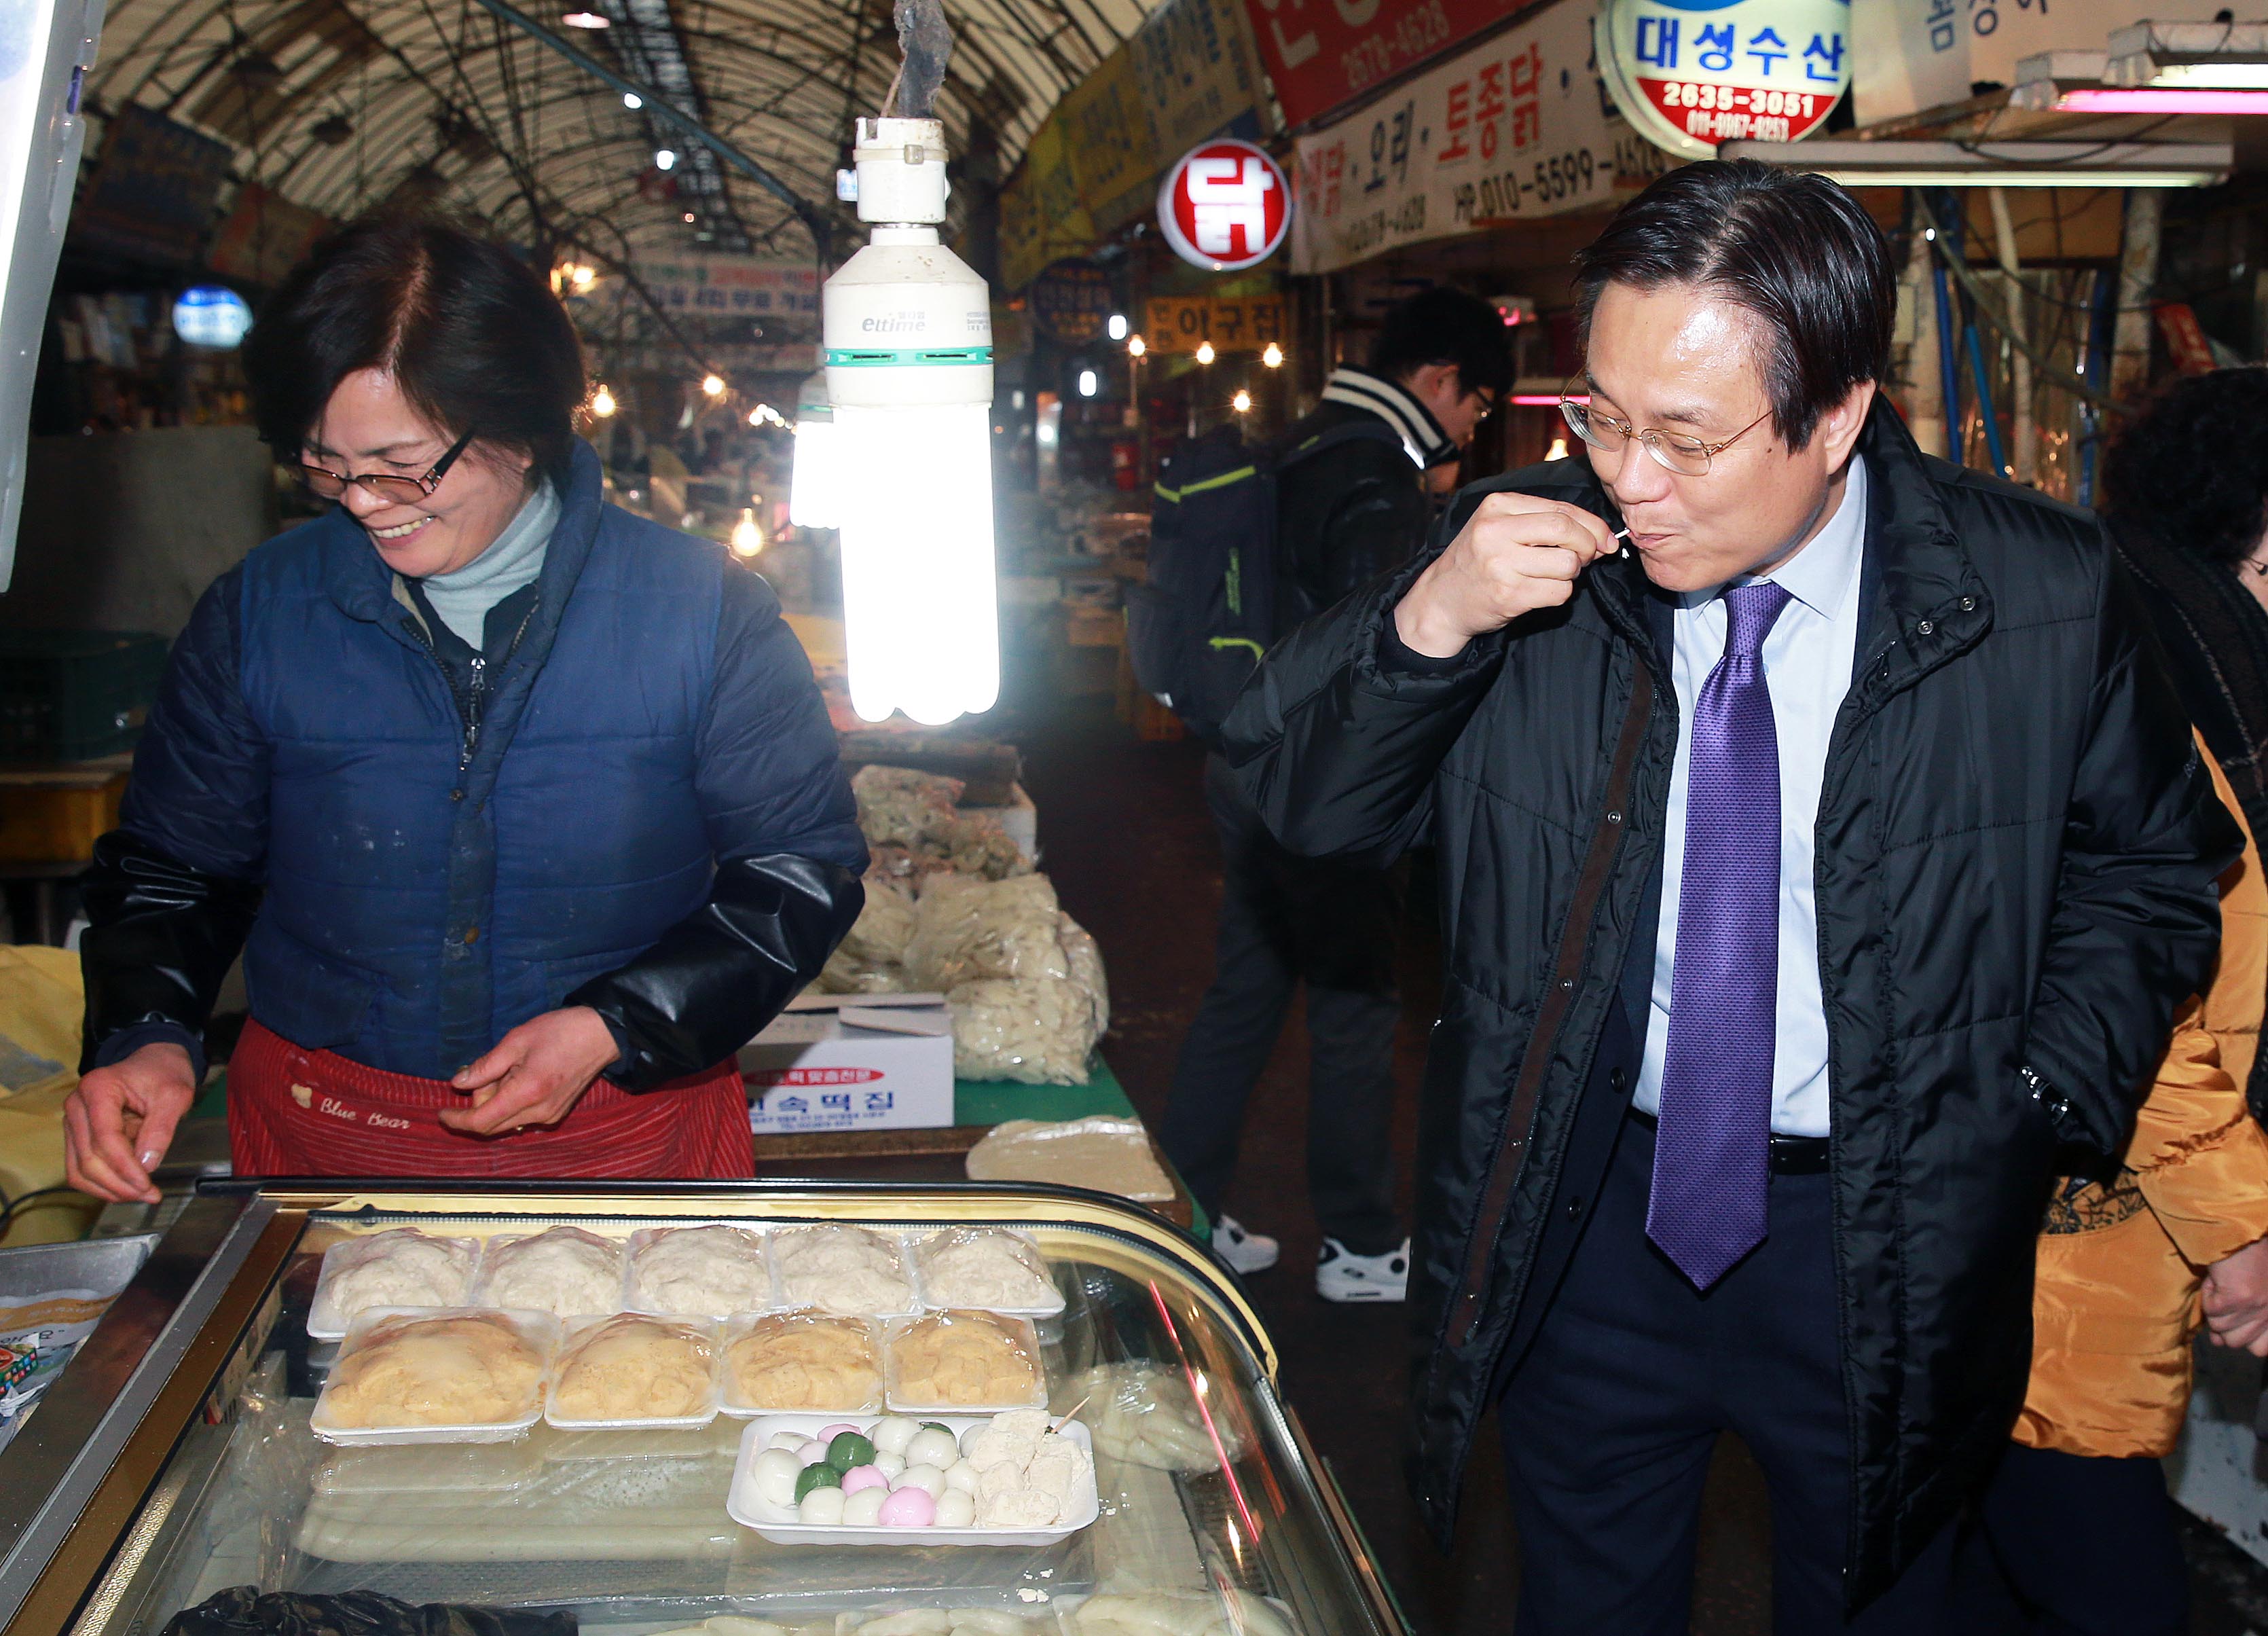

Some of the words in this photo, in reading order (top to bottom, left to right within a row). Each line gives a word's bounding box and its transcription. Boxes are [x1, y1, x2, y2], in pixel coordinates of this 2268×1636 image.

[1636, 17, 1844, 81] 대성수산
[1438, 41, 1543, 162] 토종닭
[1662, 81, 1814, 118] 2635-3051
[1186, 158, 1274, 254] 닭
[320, 1097, 356, 1121] Blue
